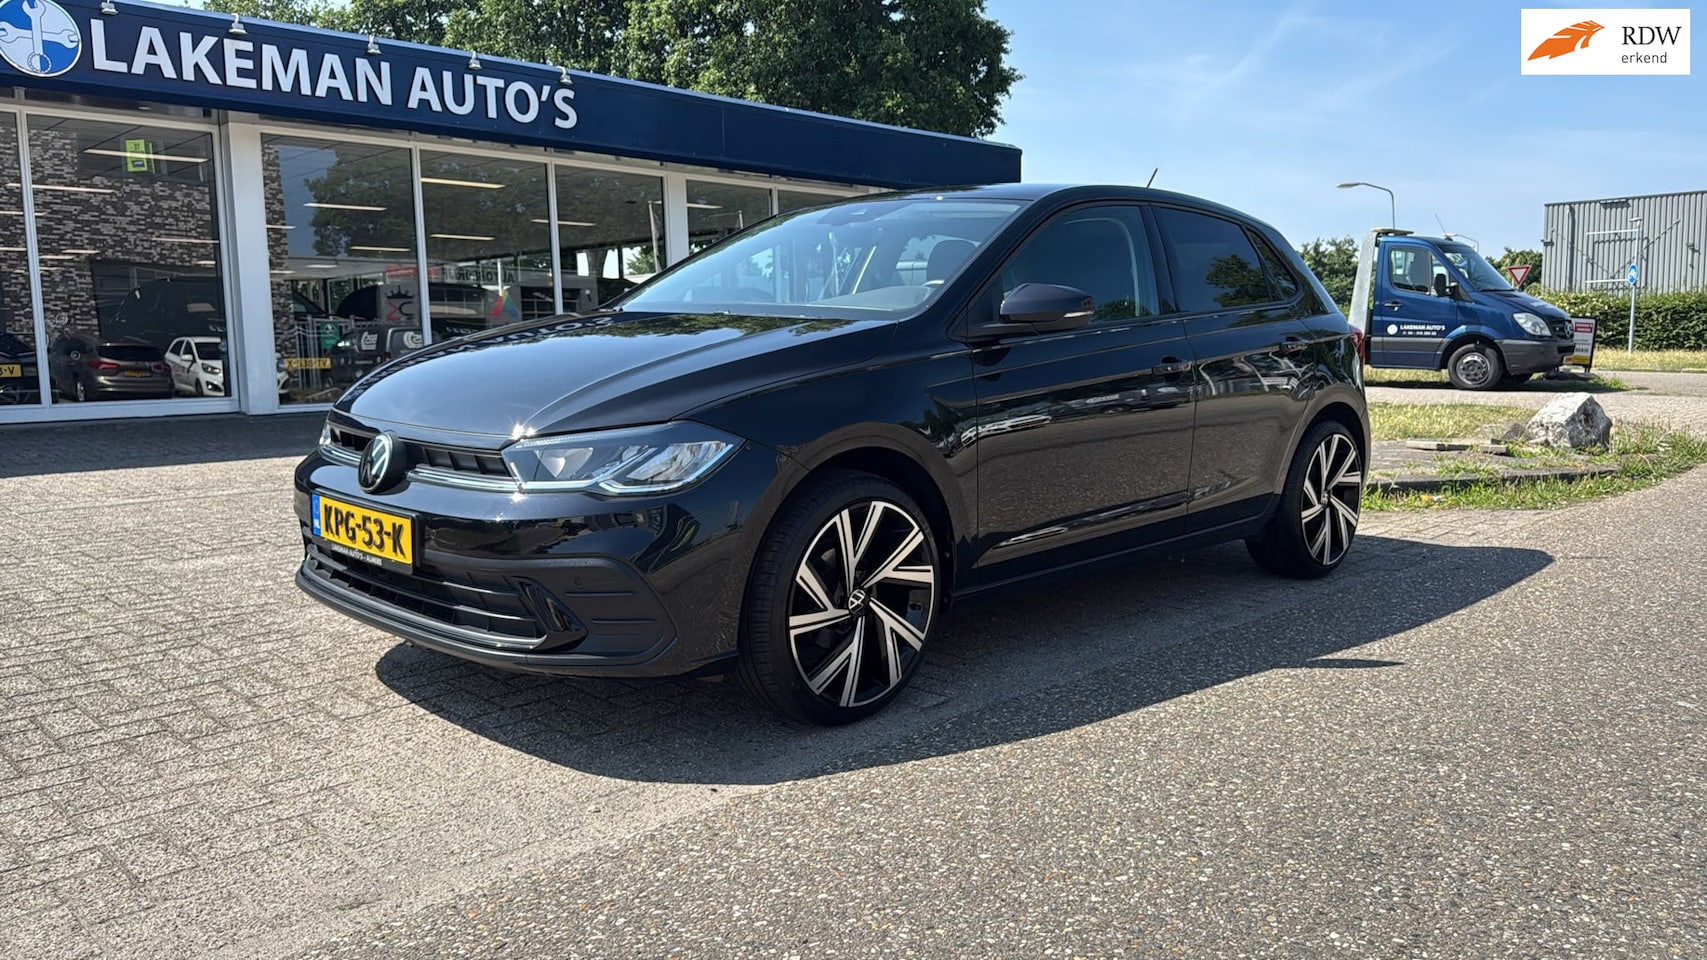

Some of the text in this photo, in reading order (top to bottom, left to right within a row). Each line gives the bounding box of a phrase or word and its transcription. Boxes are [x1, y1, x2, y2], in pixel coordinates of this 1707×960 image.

[90, 18, 578, 129] LAKEMAN AUTO'S
[324, 504, 406, 559] KPG-53-K
